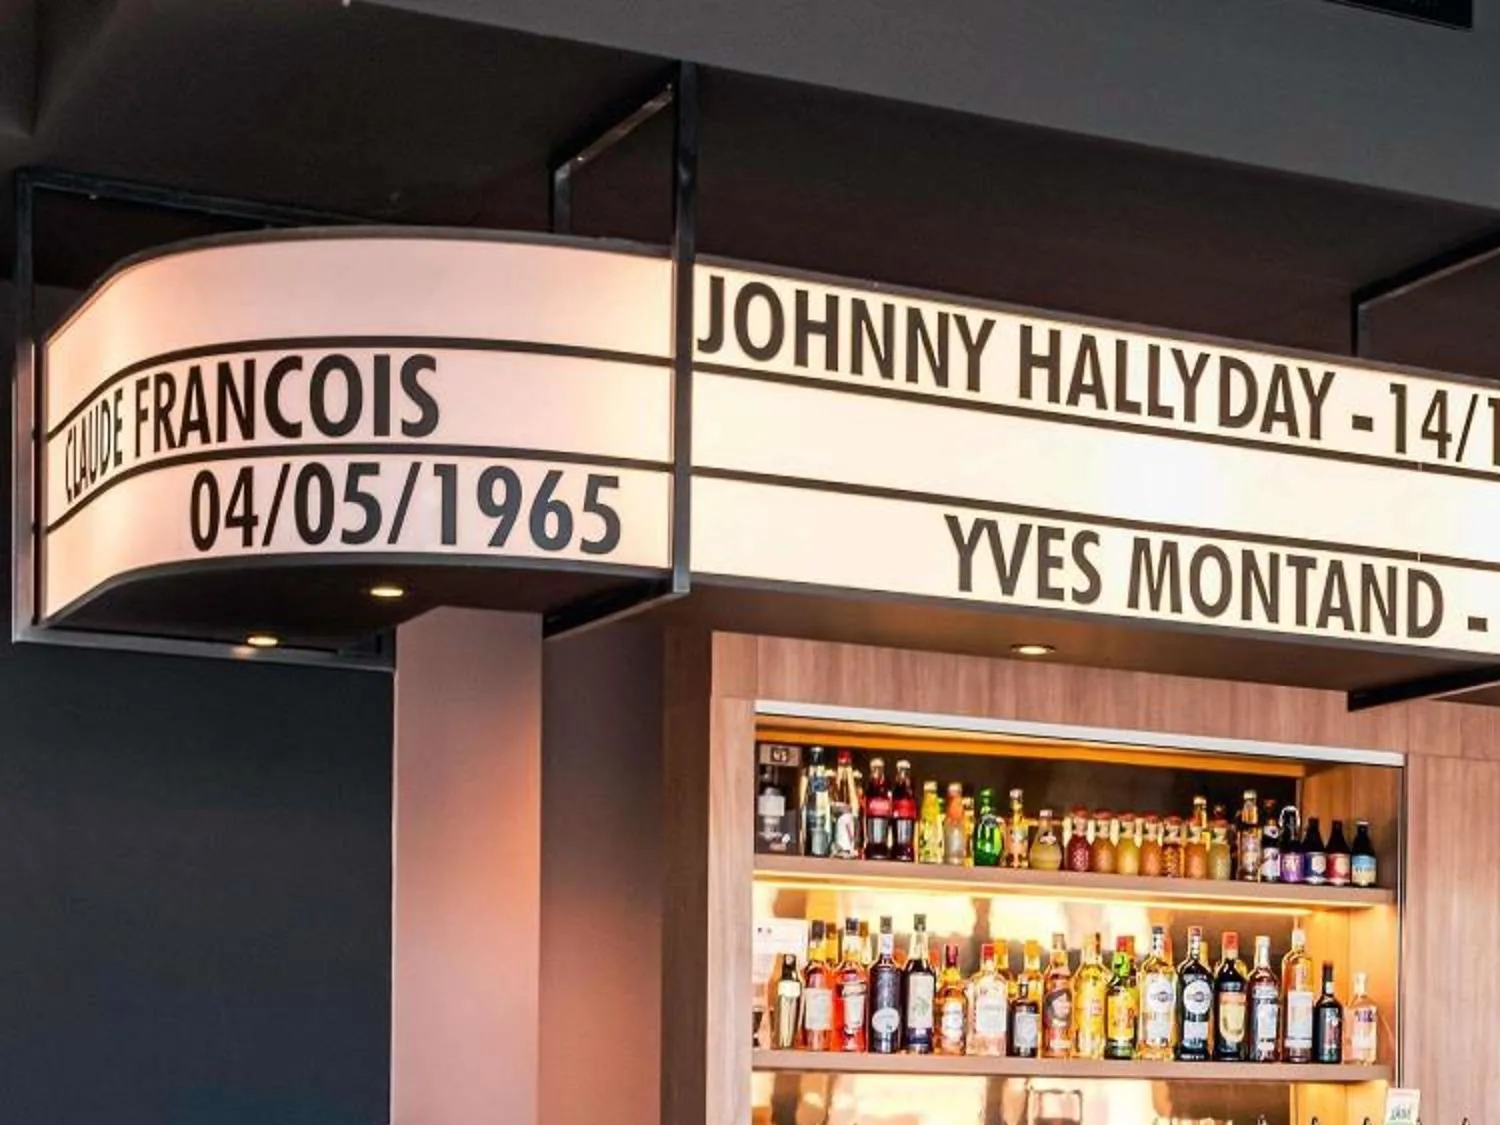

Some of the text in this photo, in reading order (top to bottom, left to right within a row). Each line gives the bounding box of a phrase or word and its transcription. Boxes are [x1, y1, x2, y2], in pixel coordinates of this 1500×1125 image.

[696, 274, 997, 393] JOHNNY
[1018, 323, 1336, 441] HALLYDAY
[65, 353, 440, 504] CLAUDE FRANCOIS
[189, 461, 621, 555] 04/05/1965
[943, 513, 1102, 605] YVES
[1127, 536, 1444, 639] MONTAND
